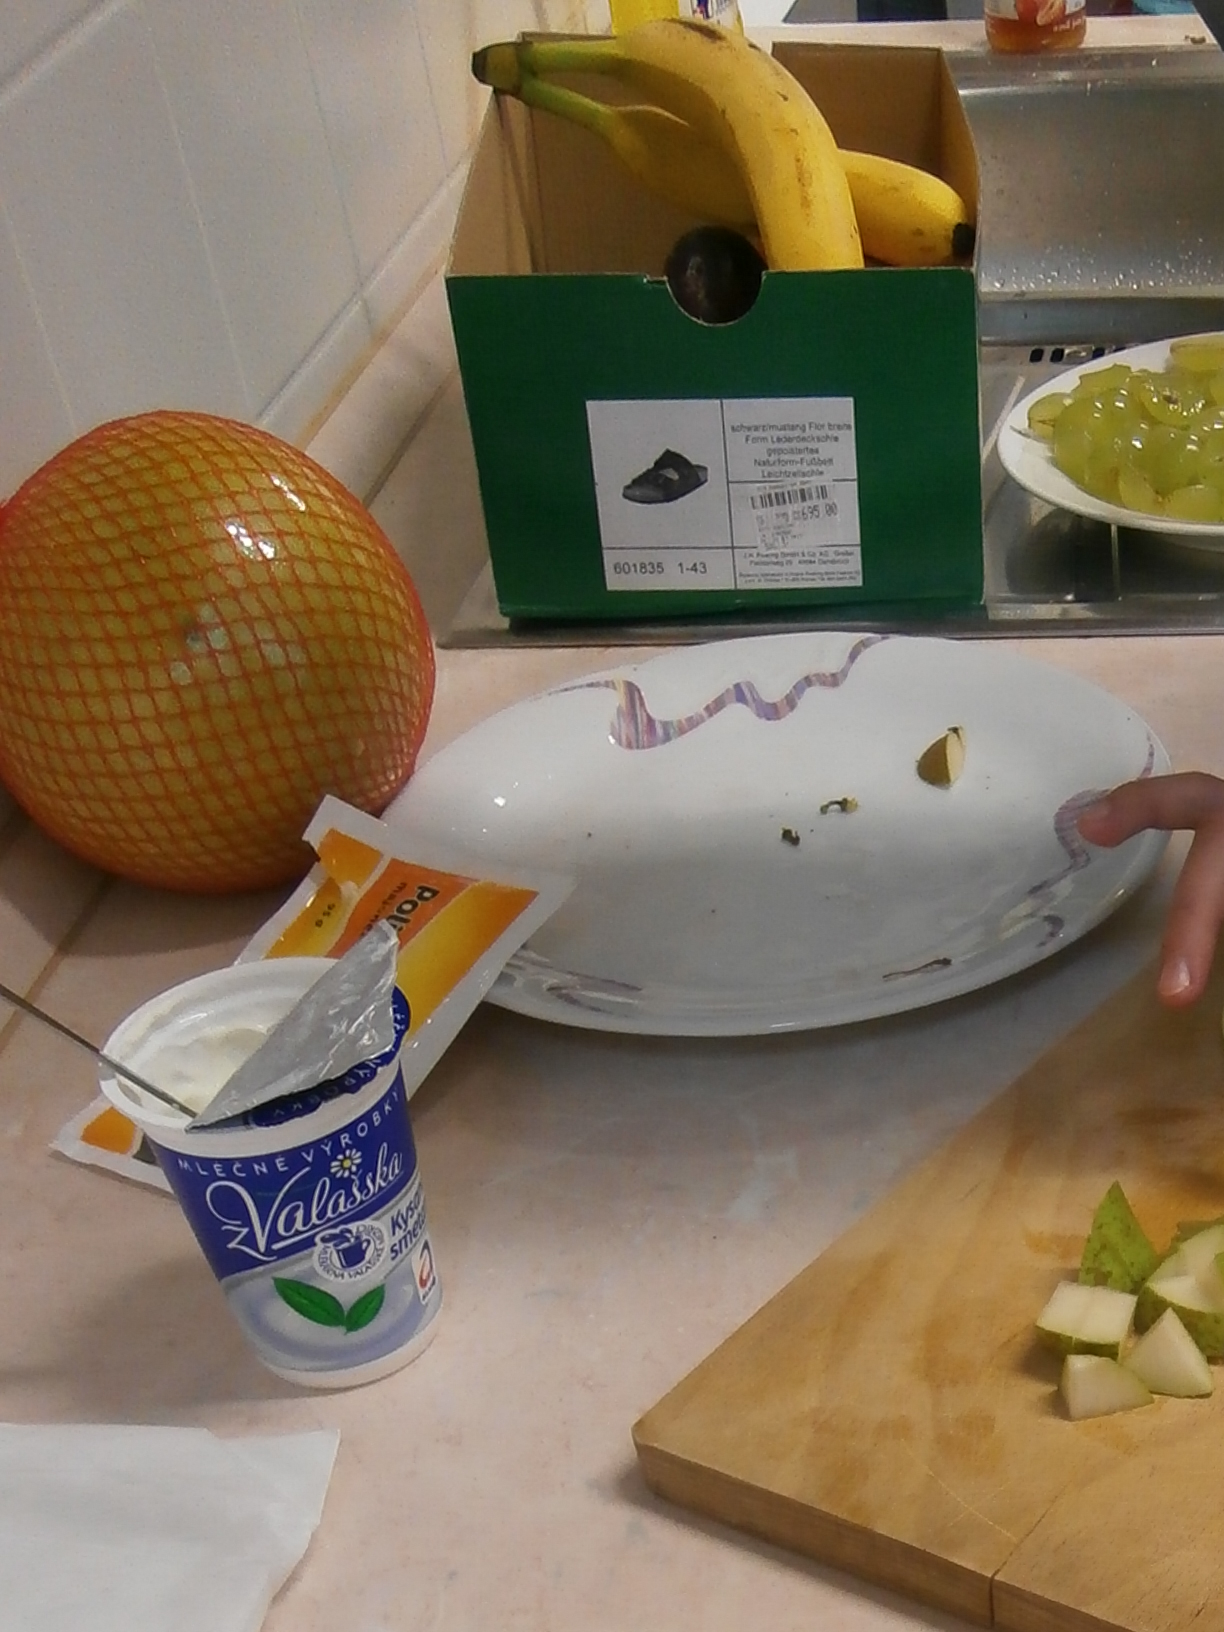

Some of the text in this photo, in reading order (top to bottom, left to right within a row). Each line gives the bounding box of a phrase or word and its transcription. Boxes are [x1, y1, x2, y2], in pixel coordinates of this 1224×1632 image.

[613, 561, 708, 575] 601835 1-43
[385, 885, 440, 933] Poli
